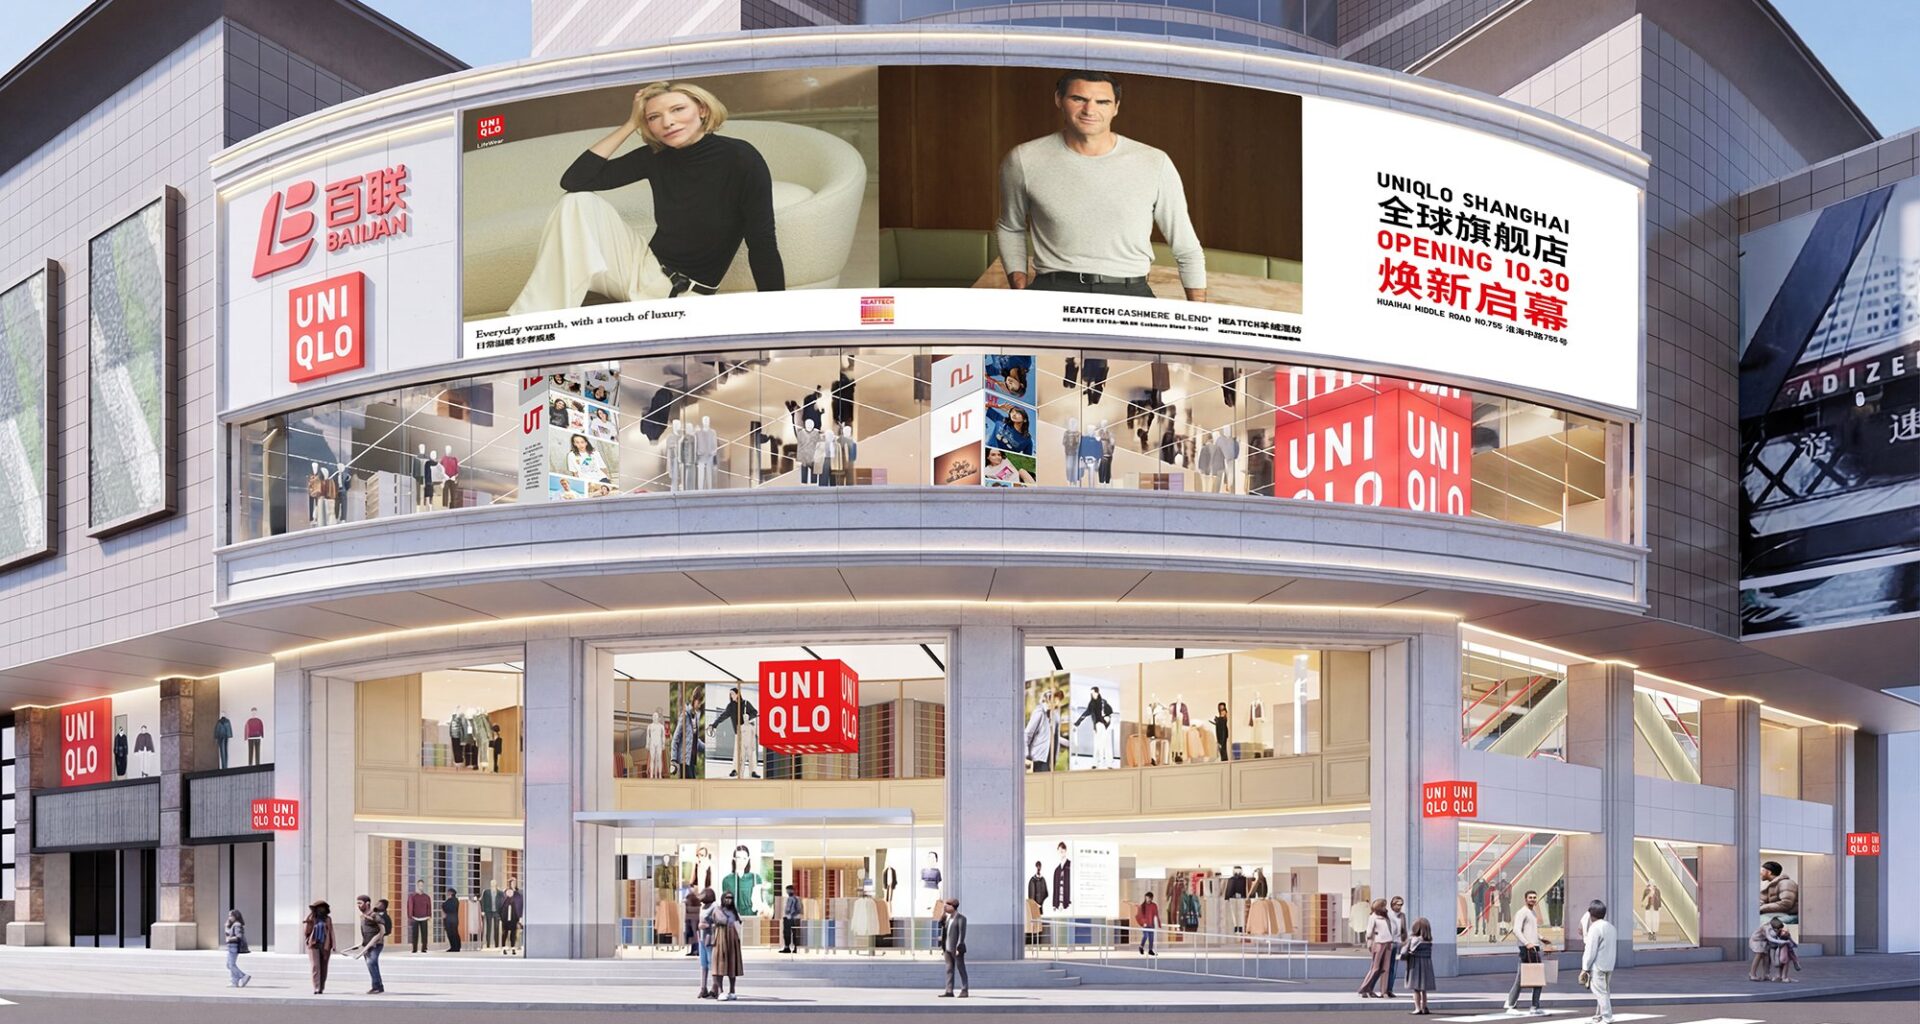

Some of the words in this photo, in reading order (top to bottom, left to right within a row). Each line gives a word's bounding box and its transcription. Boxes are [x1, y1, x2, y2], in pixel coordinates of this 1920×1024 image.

[480, 118, 500, 128] UNI
[480, 126, 502, 136] QLO
[325, 164, 406, 228] 百联
[1377, 172, 1453, 202] UNIQLO
[1463, 193, 1570, 234] SHANGHAI
[328, 212, 406, 252] BAILIAN
[1378, 195, 1568, 268] 全球旗舰店
[1377, 230, 1492, 272] OPENING
[1505, 258, 1570, 292] 10.30
[296, 285, 348, 328] UNI
[1378, 256, 1568, 332] 焕新启幕
[476, 326, 522, 338] Everyday
[525, 319, 568, 332] warmth,
[570, 318, 594, 328] with
[606, 314, 634, 324] touch
[638, 311, 651, 320] of
[651, 310, 686, 320] luxury.
[1062, 306, 1115, 316] HEATTECH
[1118, 308, 1170, 320] CASHMERE
[1376, 298, 1412, 310] HUAIHAI
[1414, 304, 1446, 318] MIDDLE
[1448, 312, 1472, 323] ROAD
[1475, 318, 1503, 330] NO.755
[296, 324, 352, 370] QLO
[524, 404, 544, 434] UT
[950, 409, 972, 434] UT
[1290, 415, 1373, 478] UNI
[1408, 410, 1459, 475] UNI
[769, 670, 824, 699] UNI
[842, 672, 856, 708] UNI
[66, 710, 94, 742] UNI
[769, 704, 830, 738] QLO
[842, 708, 856, 740] QLO
[65, 745, 98, 780] QLO
[1426, 786, 1446, 800] UNI
[1454, 786, 1472, 798] UNI
[1454, 800, 1474, 814] QLO
[254, 804, 268, 814] UNI
[254, 816, 268, 828] QLO
[274, 804, 294, 814] UNI
[274, 816, 296, 828] QLO
[1426, 800, 1448, 815] QLO
[1850, 836, 1866, 844] UNI
[1850, 845, 1868, 854] QLO
